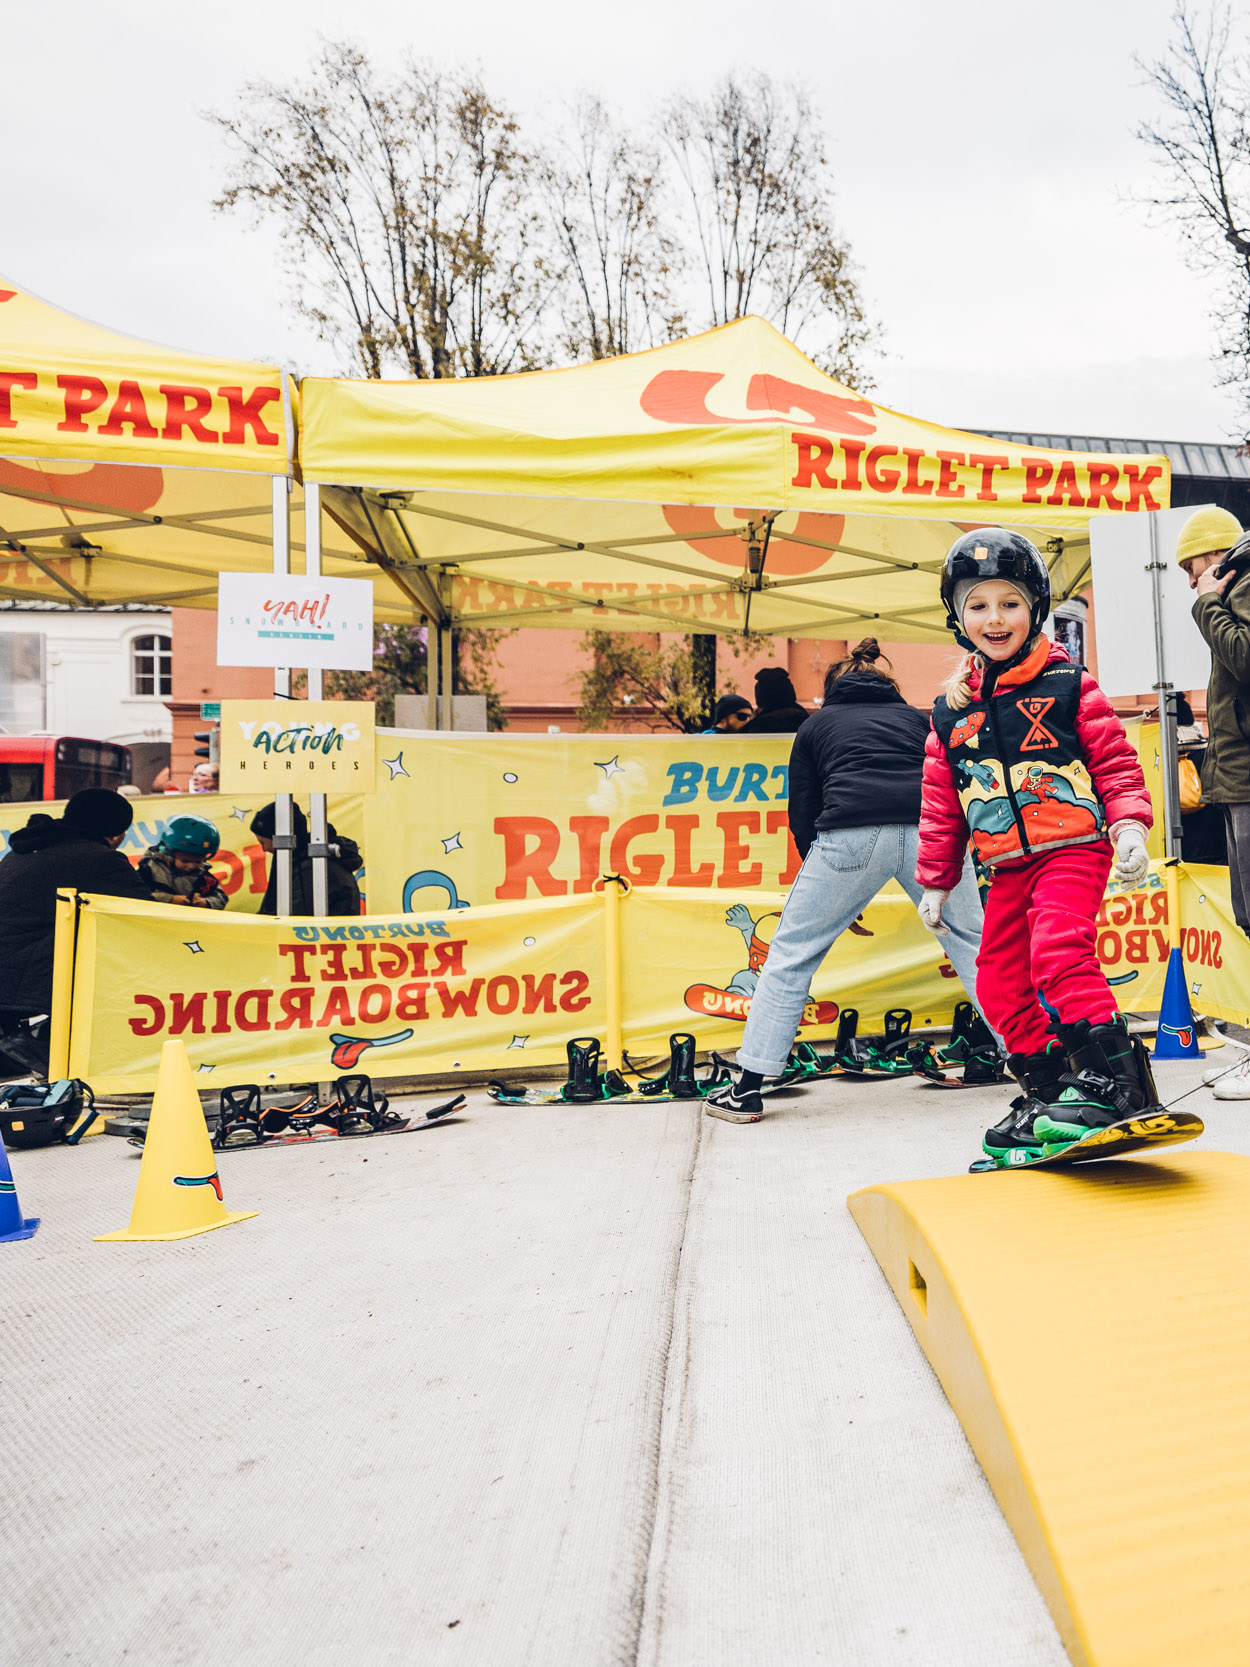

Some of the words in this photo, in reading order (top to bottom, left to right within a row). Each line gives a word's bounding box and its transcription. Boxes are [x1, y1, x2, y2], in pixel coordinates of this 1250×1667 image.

[57, 374, 281, 446] PARK
[790, 432, 1010, 501] RIGLET
[1020, 457, 1163, 512] PARK
[263, 593, 331, 629] YAH!
[240, 761, 359, 770] HEROES
[662, 761, 789, 807] BURT
